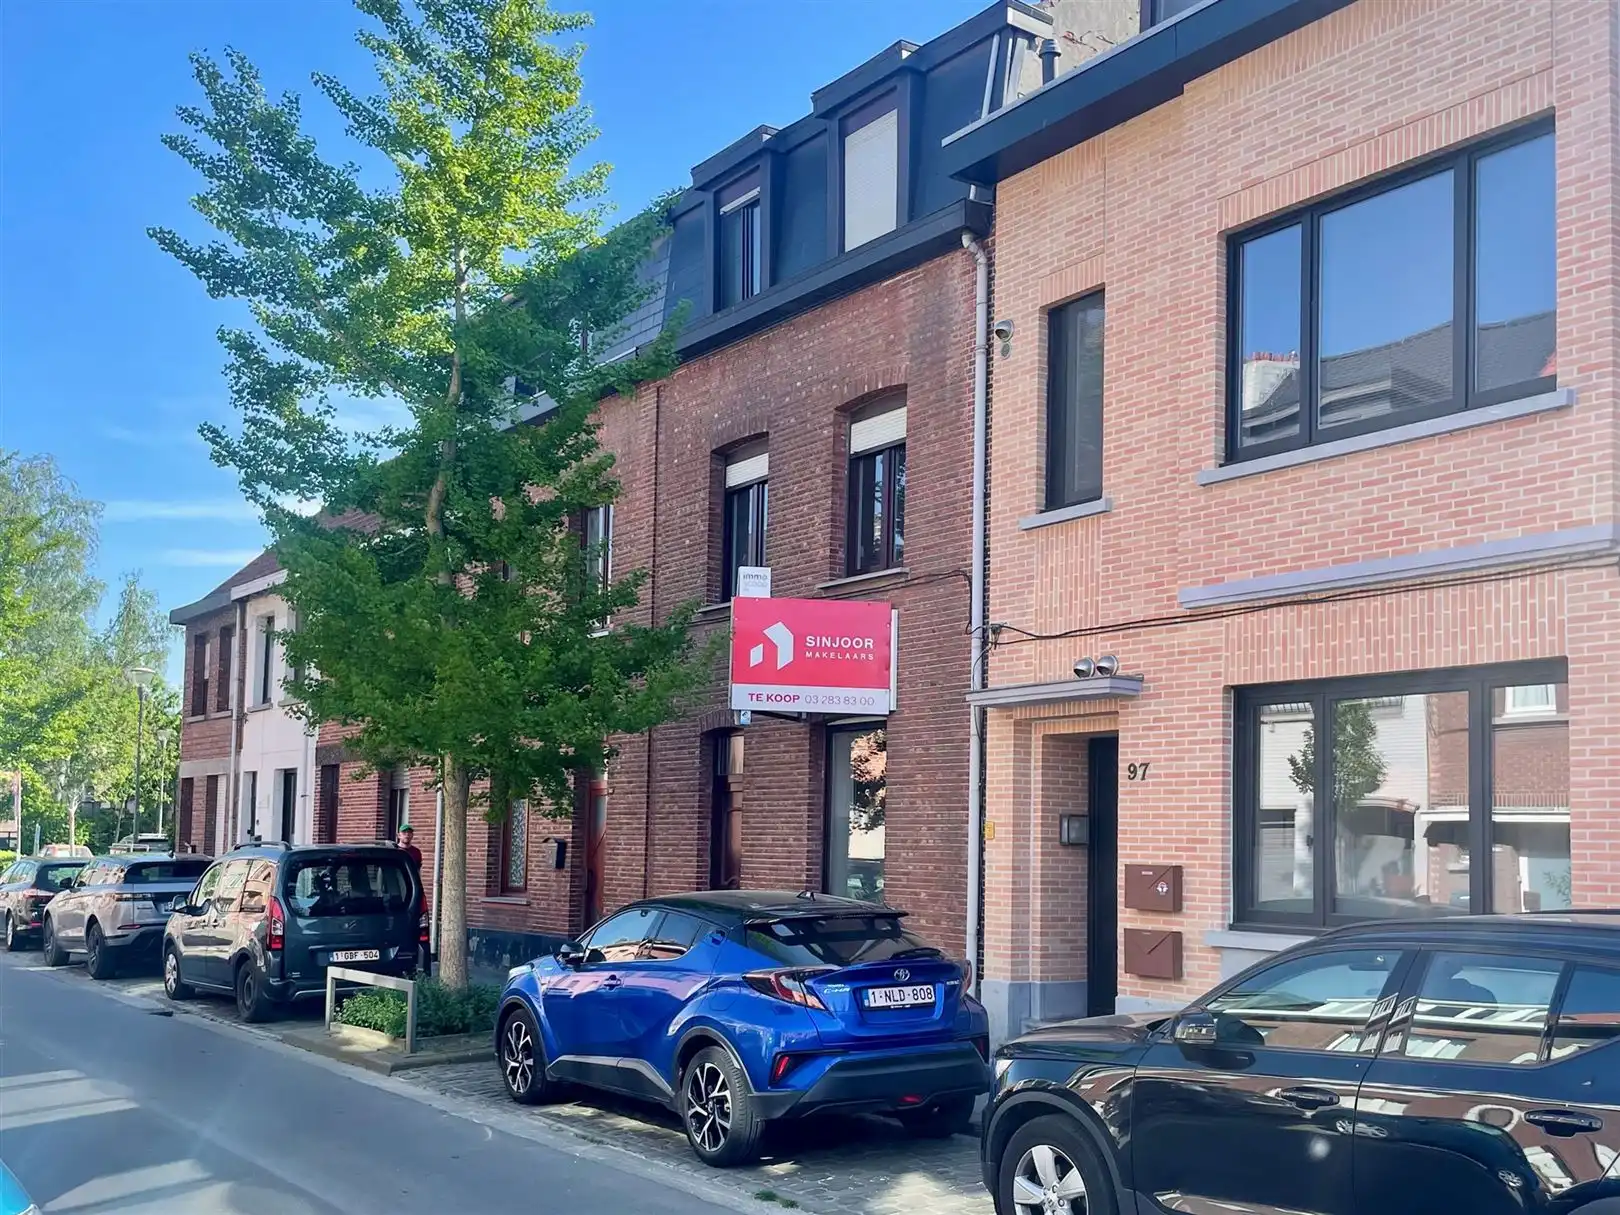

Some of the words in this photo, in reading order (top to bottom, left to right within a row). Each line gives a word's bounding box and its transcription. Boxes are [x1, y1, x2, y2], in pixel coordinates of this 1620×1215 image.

[805, 635, 874, 649] SINJOOR
[805, 651, 874, 660] MAKELAARS
[748, 693, 763, 702] TE
[766, 693, 801, 704] KOOP
[804, 694, 819, 704] 03
[821, 695, 841, 705] 283
[843, 696, 857, 705] 83
[859, 696, 875, 706] 00
[1127, 762, 1151, 781] 97
[871, 987, 933, 1003] 1-NLD-808
